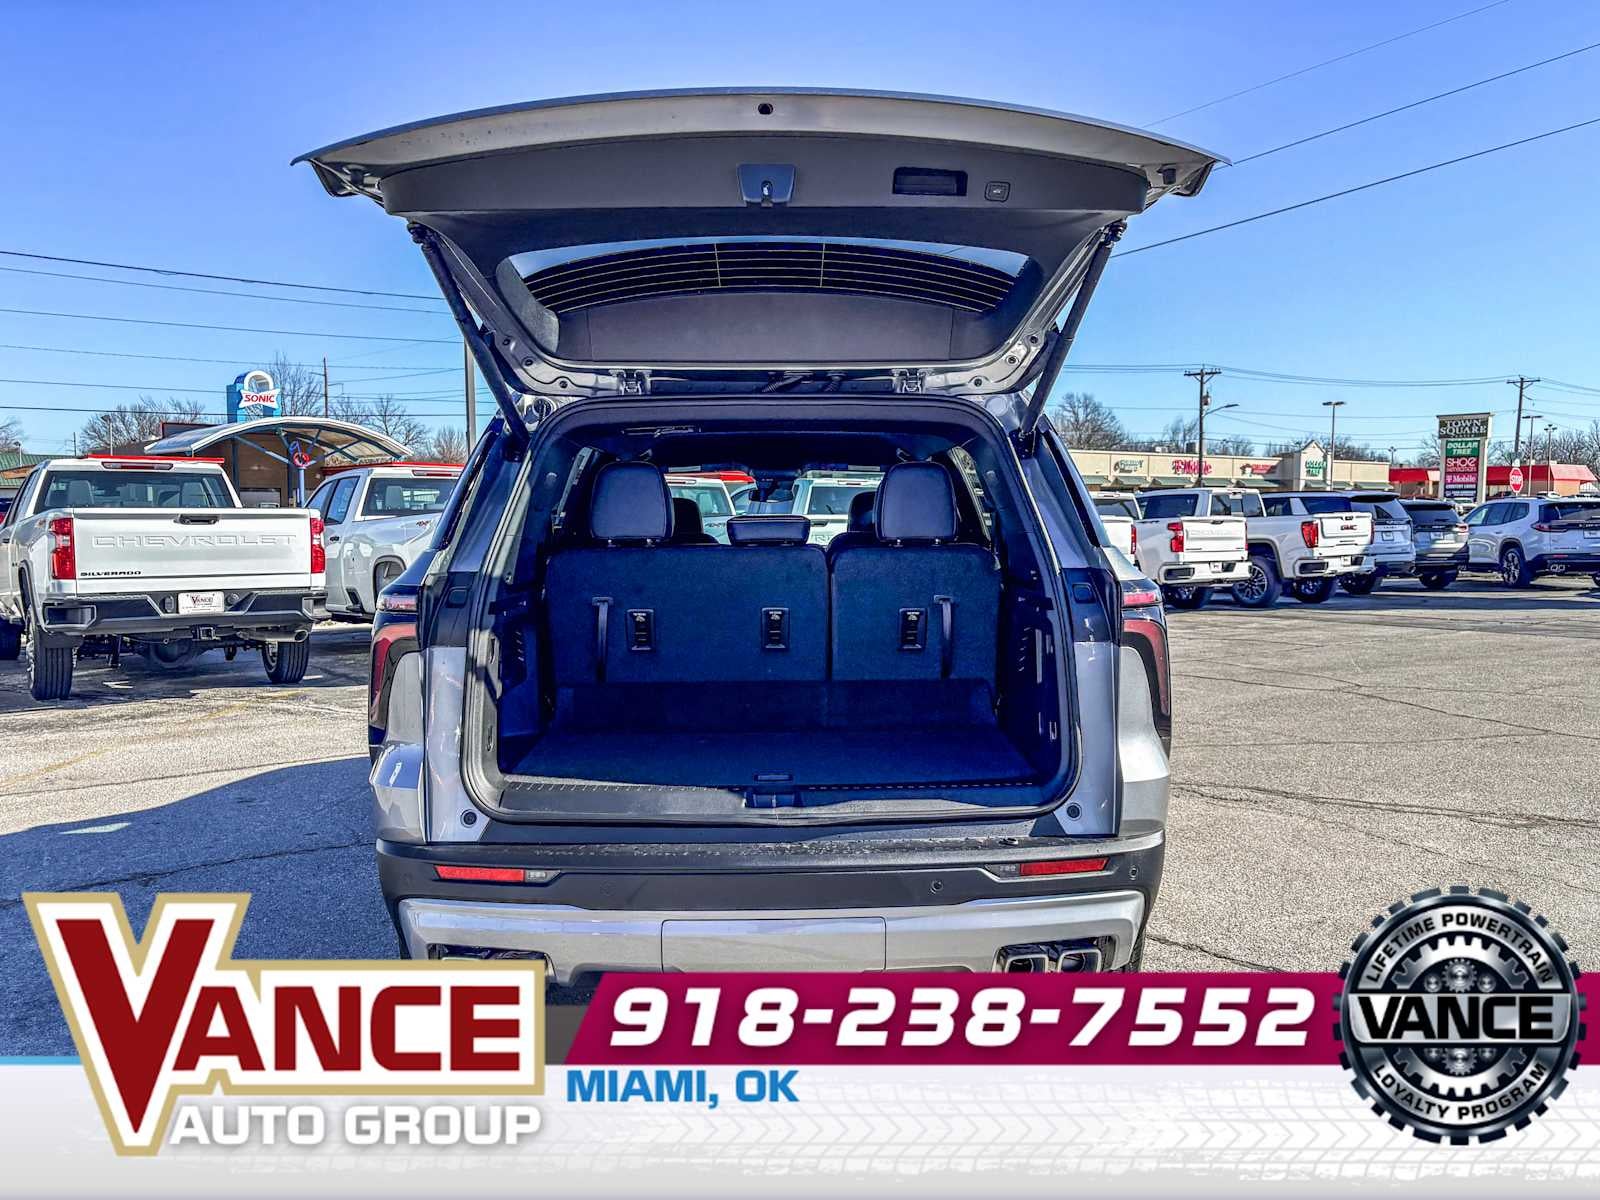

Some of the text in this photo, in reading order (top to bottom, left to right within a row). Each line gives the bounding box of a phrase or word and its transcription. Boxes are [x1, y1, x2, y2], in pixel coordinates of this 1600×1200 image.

[244, 394, 275, 403] SONIC
[1446, 419, 1481, 428] TOWN
[1440, 426, 1487, 436] SQUARE
[1452, 448, 1472, 456] TREE
[92, 534, 297, 548] CHEVROLET
